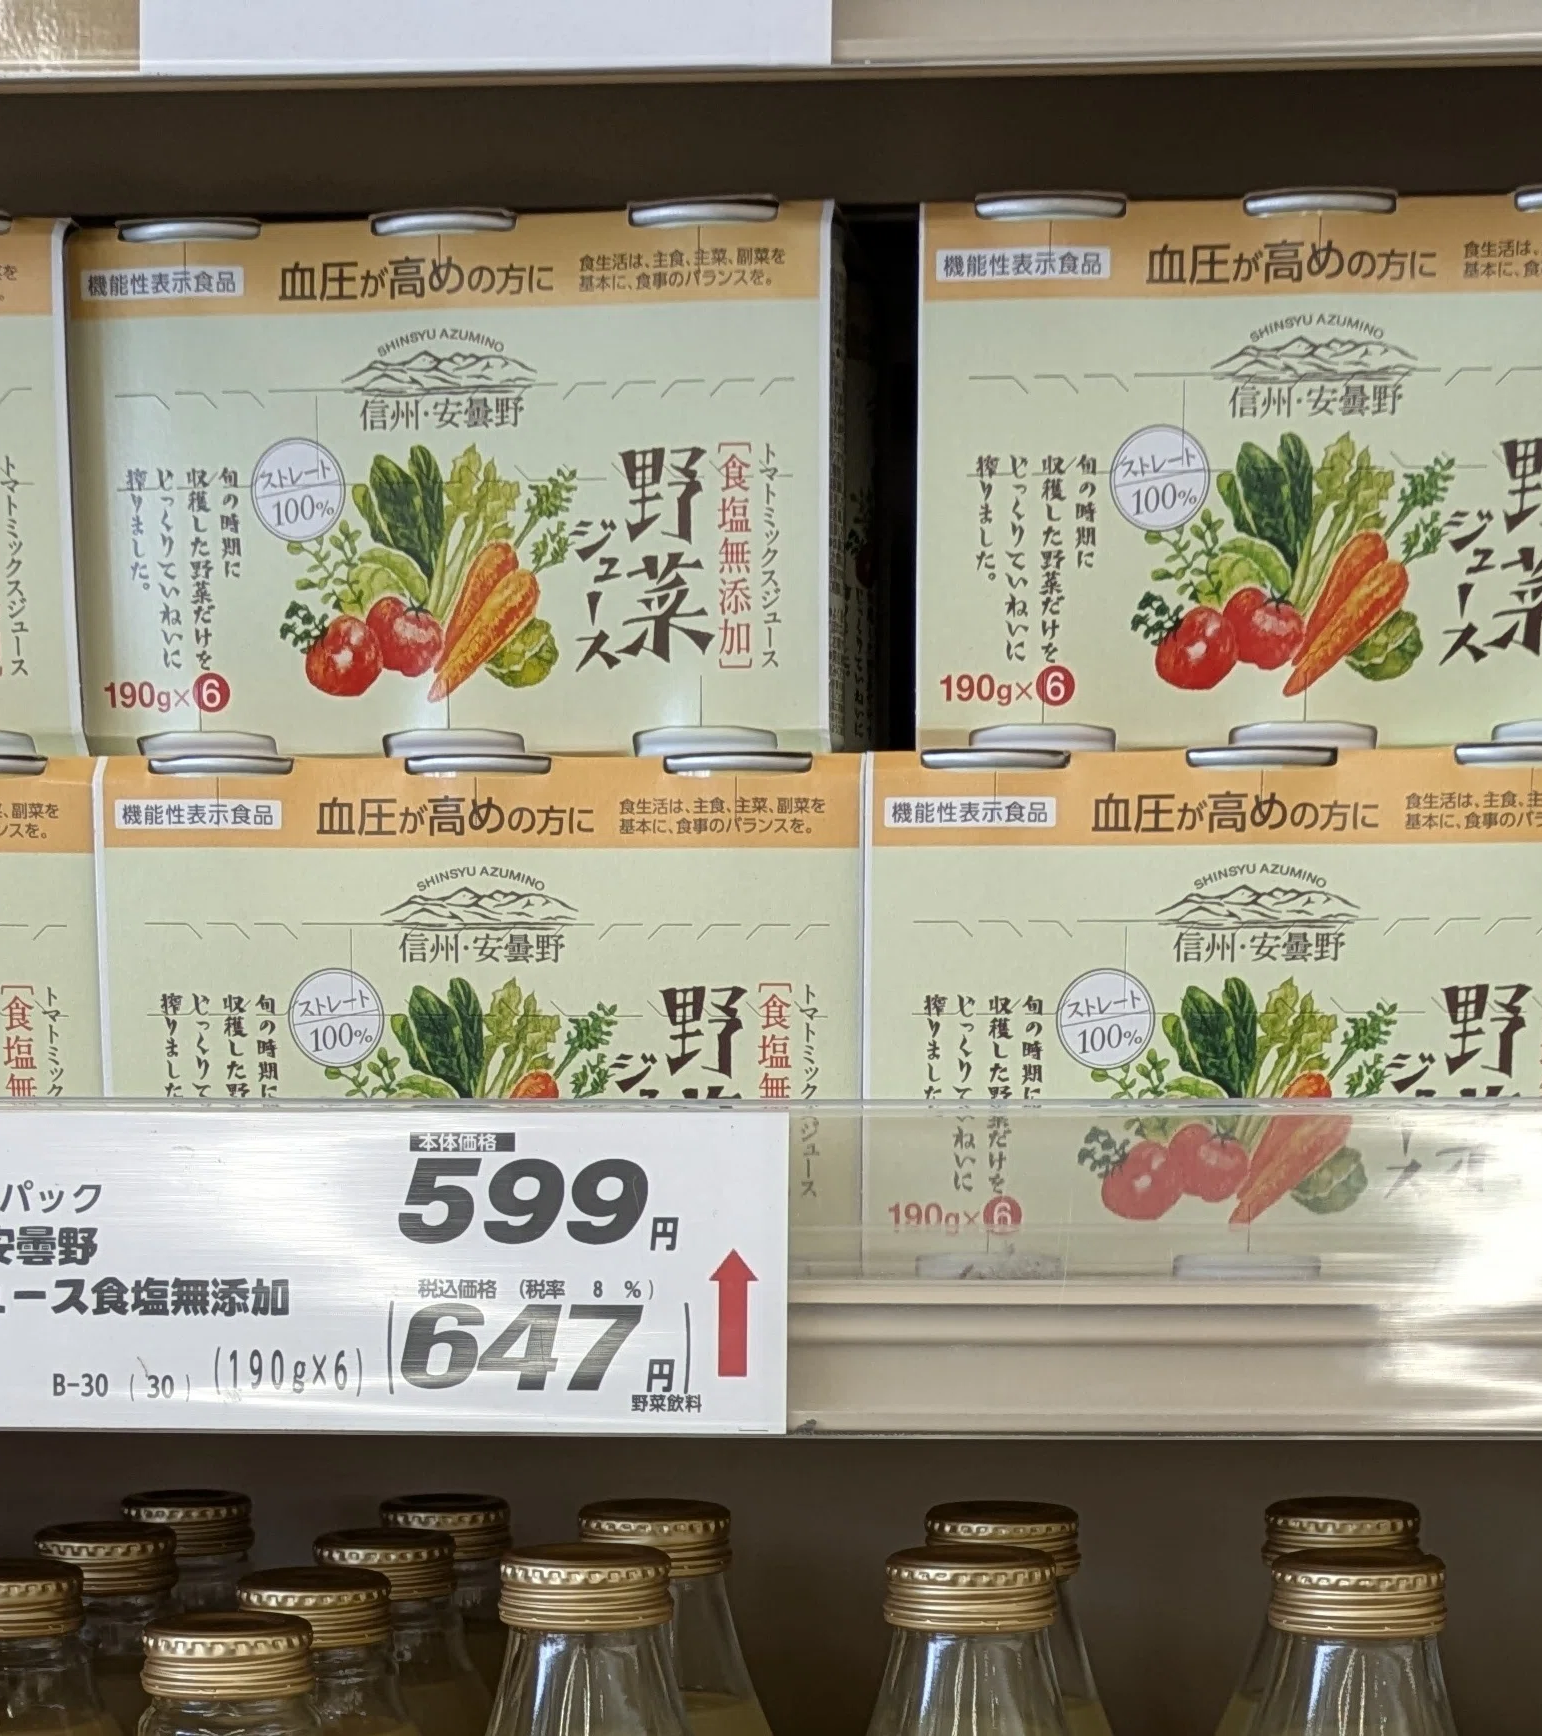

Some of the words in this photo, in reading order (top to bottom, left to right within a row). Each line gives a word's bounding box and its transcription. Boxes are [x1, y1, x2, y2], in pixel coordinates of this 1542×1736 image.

[579, 248, 785, 270] 食生活は、主食、主菜、副菜を
[943, 253, 1102, 277] 機能性表示食品
[1147, 239, 1436, 286] 血圧が高めの方に
[88, 271, 236, 296] 機能性表示食品
[279, 256, 554, 301] 血圧が高めの方に
[579, 270, 774, 291] 基本に、食事のバランスを。
[1250, 314, 1315, 343] SHINSYU
[1317, 314, 1385, 340] AZUMINO
[1120, 445, 1197, 478] ストレート
[1130, 480, 1197, 515] 100%
[624, 446, 716, 660] 野菜
[1438, 506, 1494, 665] ジュース
[122, 803, 273, 826] 機能性表示食品
[317, 796, 594, 837] 血圧が高めの方に
[892, 800, 1049, 824] 機能性表示食品
[1092, 791, 1379, 833] 血圧が高めの方に
[418, 1134, 497, 1151] 本体価格
[418, 1278, 497, 1300] 税込価格
[53, 1373, 108, 1397] B-30
[631, 1394, 702, 1413] 野菜飲料
